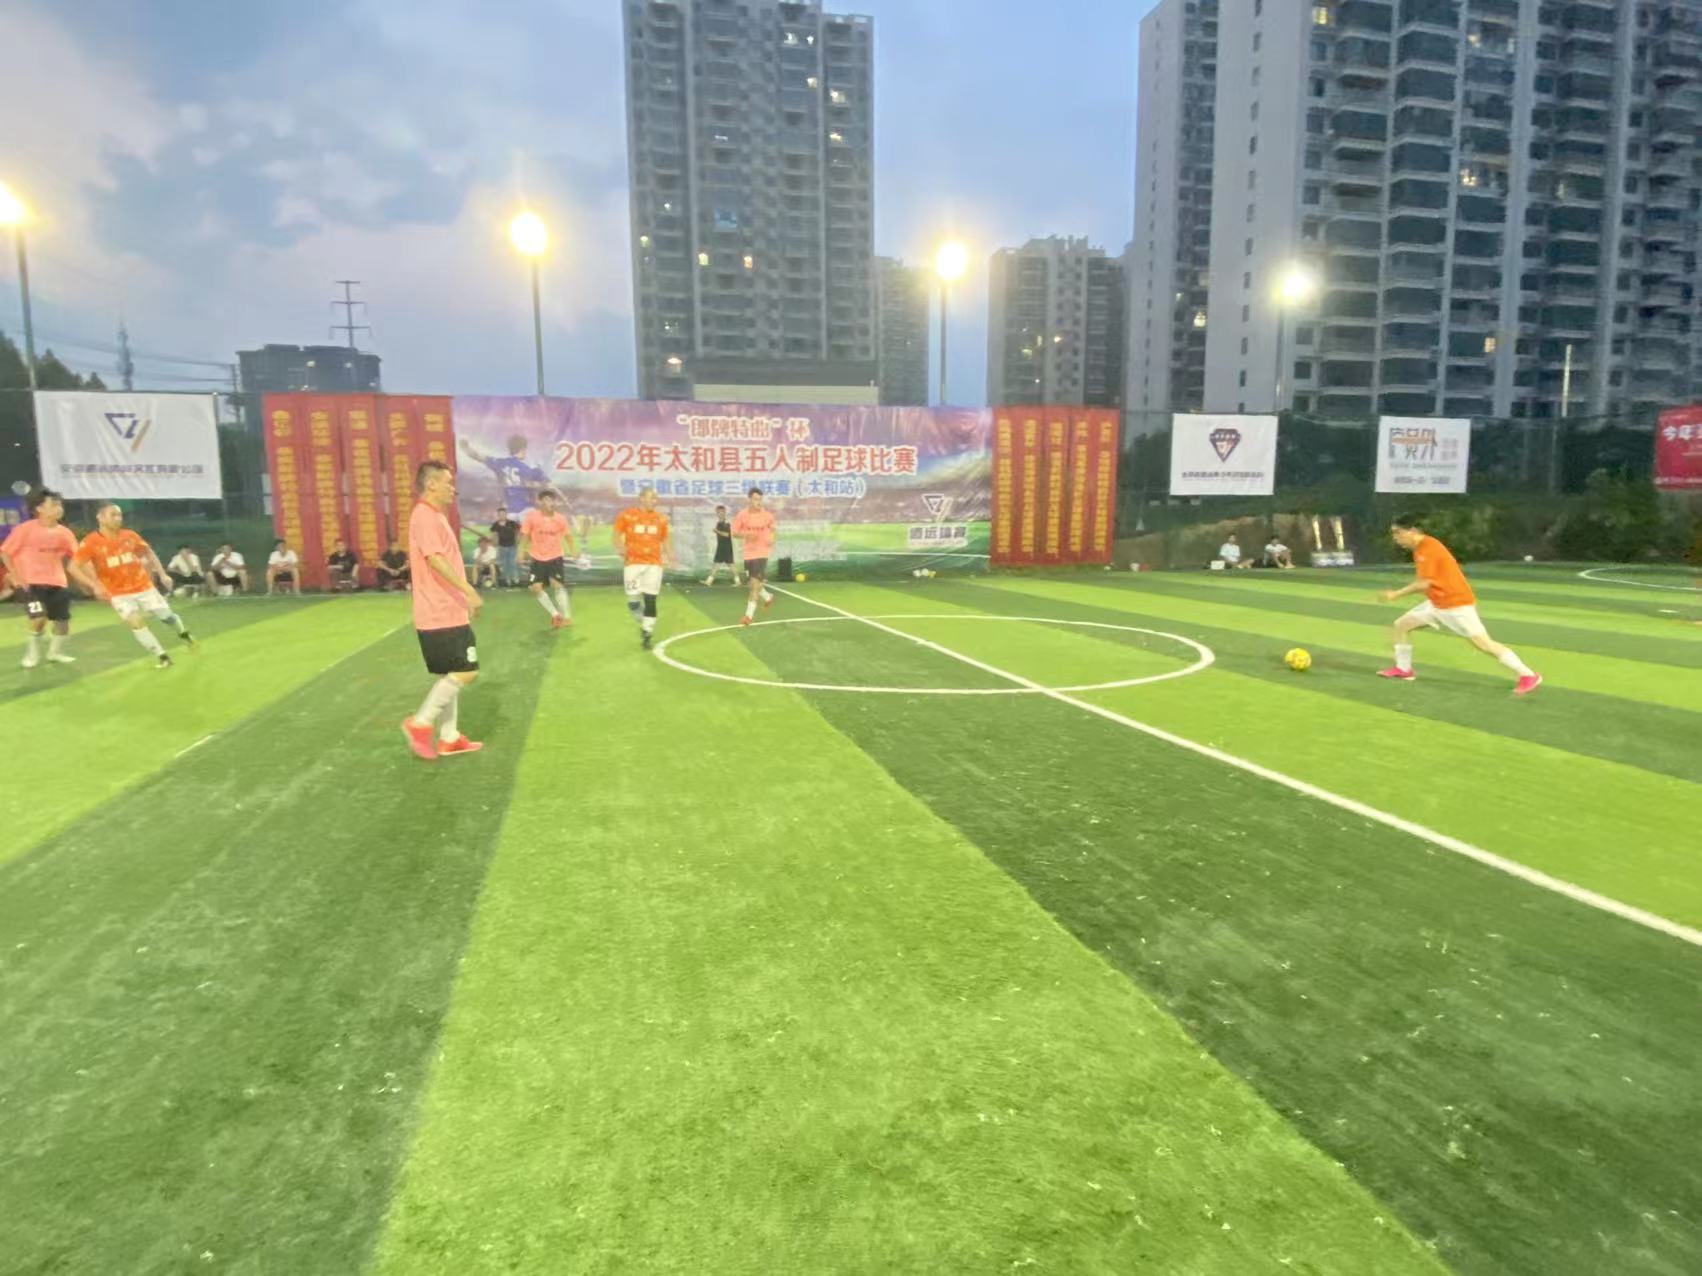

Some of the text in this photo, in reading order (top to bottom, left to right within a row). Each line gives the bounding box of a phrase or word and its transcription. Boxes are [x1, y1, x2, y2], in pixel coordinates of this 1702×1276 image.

[555, 442, 917, 474] 2022年太和县五人制足球比赛
